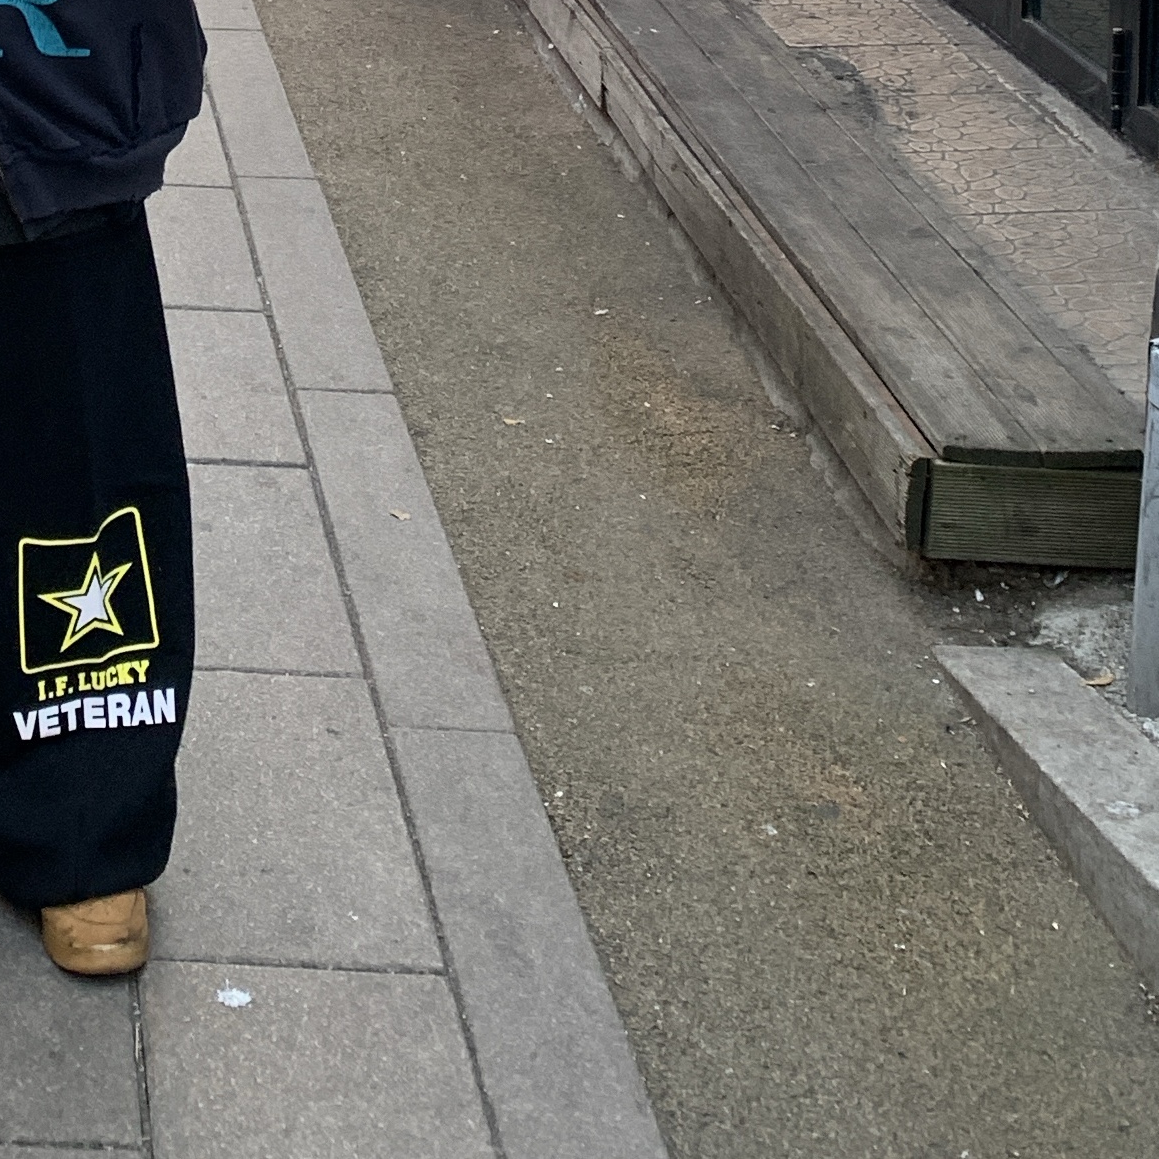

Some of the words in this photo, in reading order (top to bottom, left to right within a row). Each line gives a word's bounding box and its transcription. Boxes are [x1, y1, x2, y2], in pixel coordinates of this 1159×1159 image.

[38, 675, 75, 702] I.F.
[78, 660, 150, 691] LUCKY
[13, 687, 177, 741] VETERAN
